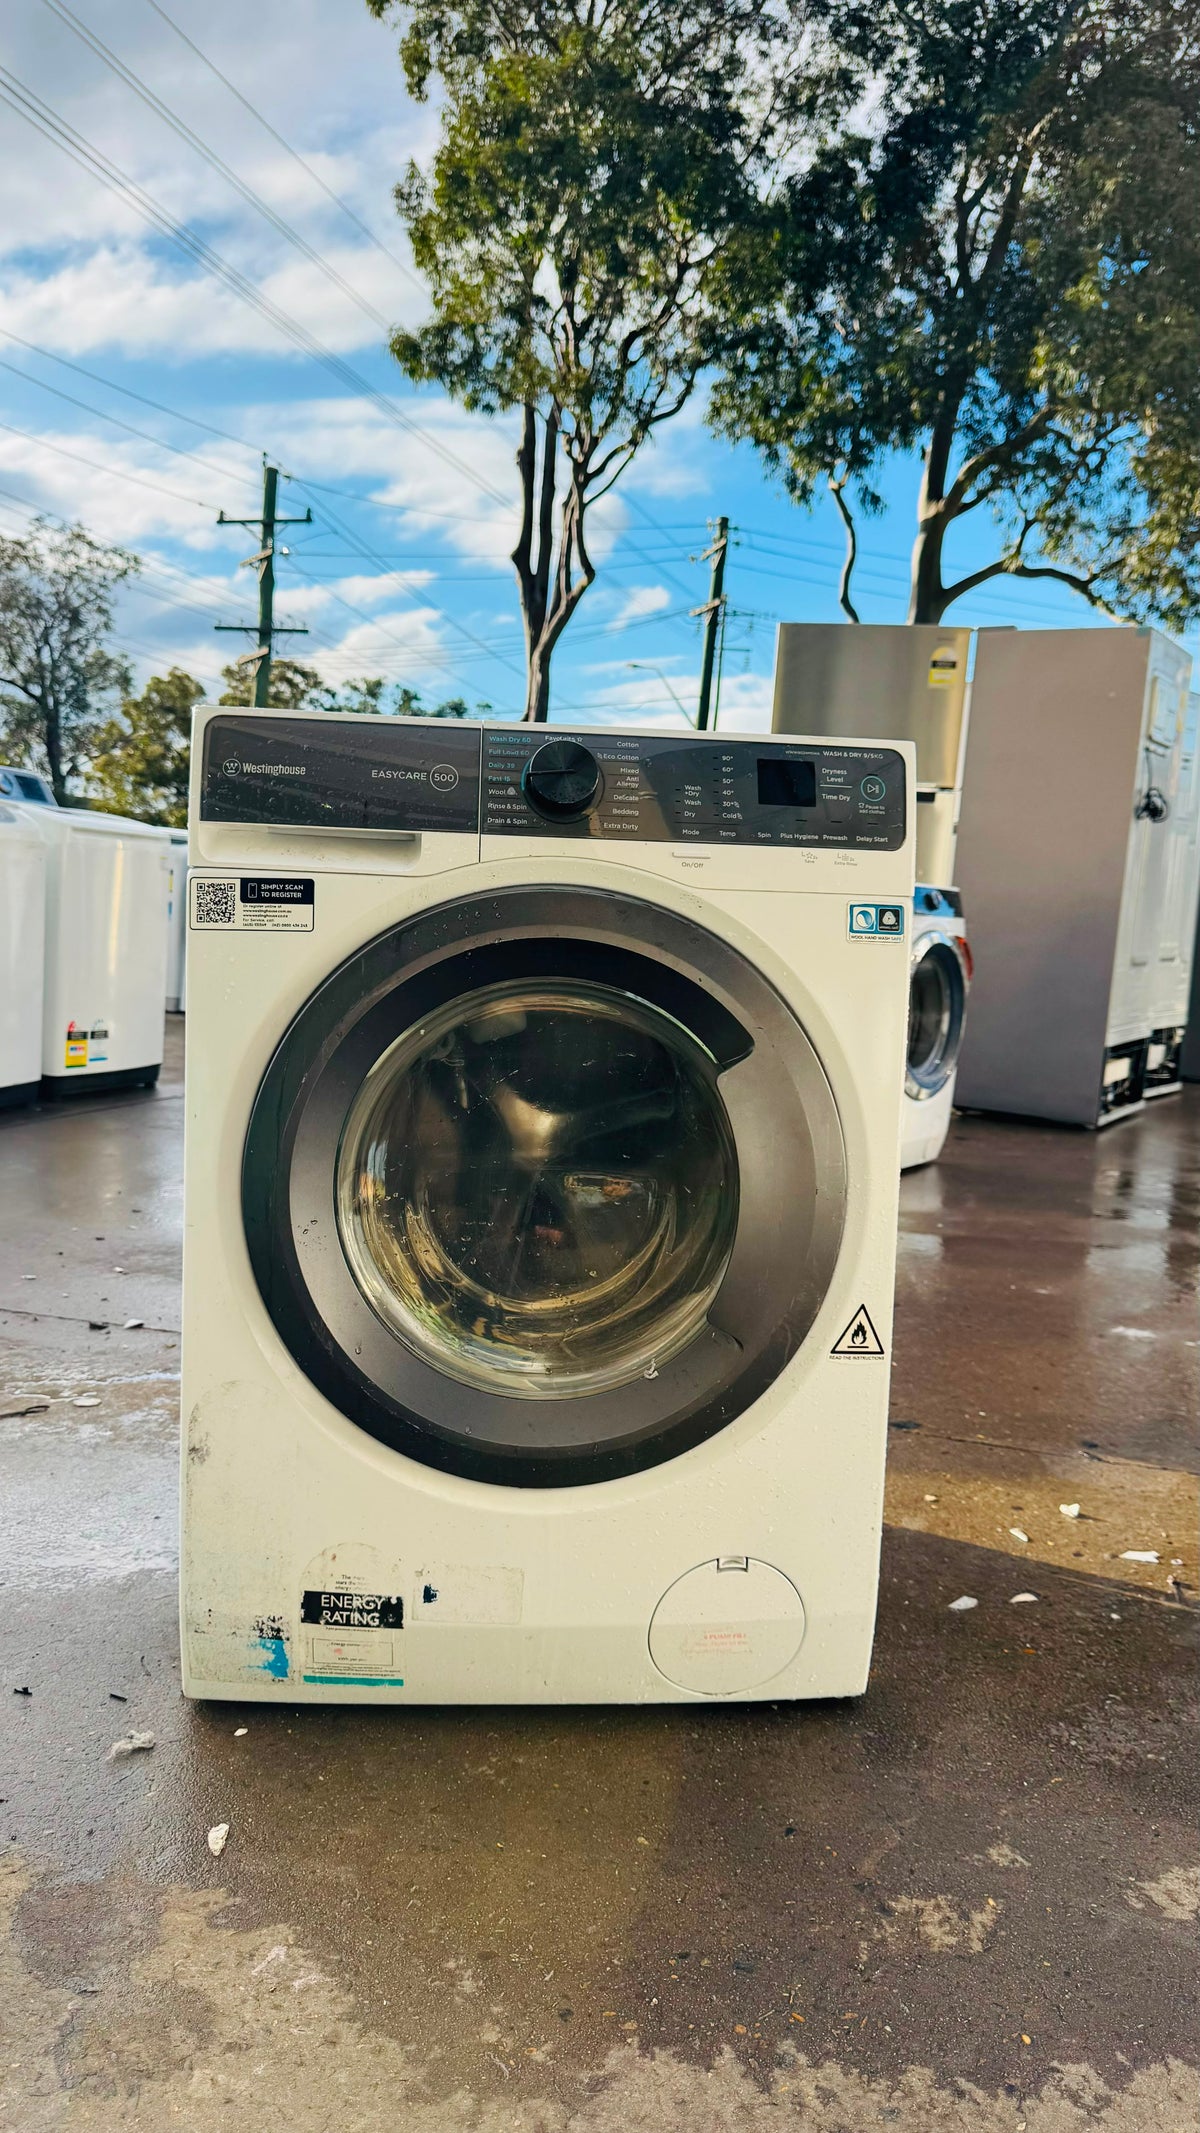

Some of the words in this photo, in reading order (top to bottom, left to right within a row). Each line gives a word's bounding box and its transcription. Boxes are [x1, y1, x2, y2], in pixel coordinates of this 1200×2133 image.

[242, 762, 306, 776] Westinghouse
[821, 767, 848, 775] Dryness
[371, 769, 428, 781] EASYCARE
[433, 773, 455, 782] 500
[616, 780, 639, 788] Allergy
[612, 808, 639, 816] Bedding
[622, 823, 639, 831] Dirty
[855, 835, 873, 843] Delay
[681, 861, 704, 869] On/Off
[271, 891, 302, 899] REGISTER
[320, 1594, 385, 1611] ENERGY
[321, 1610, 380, 1626] RATING
